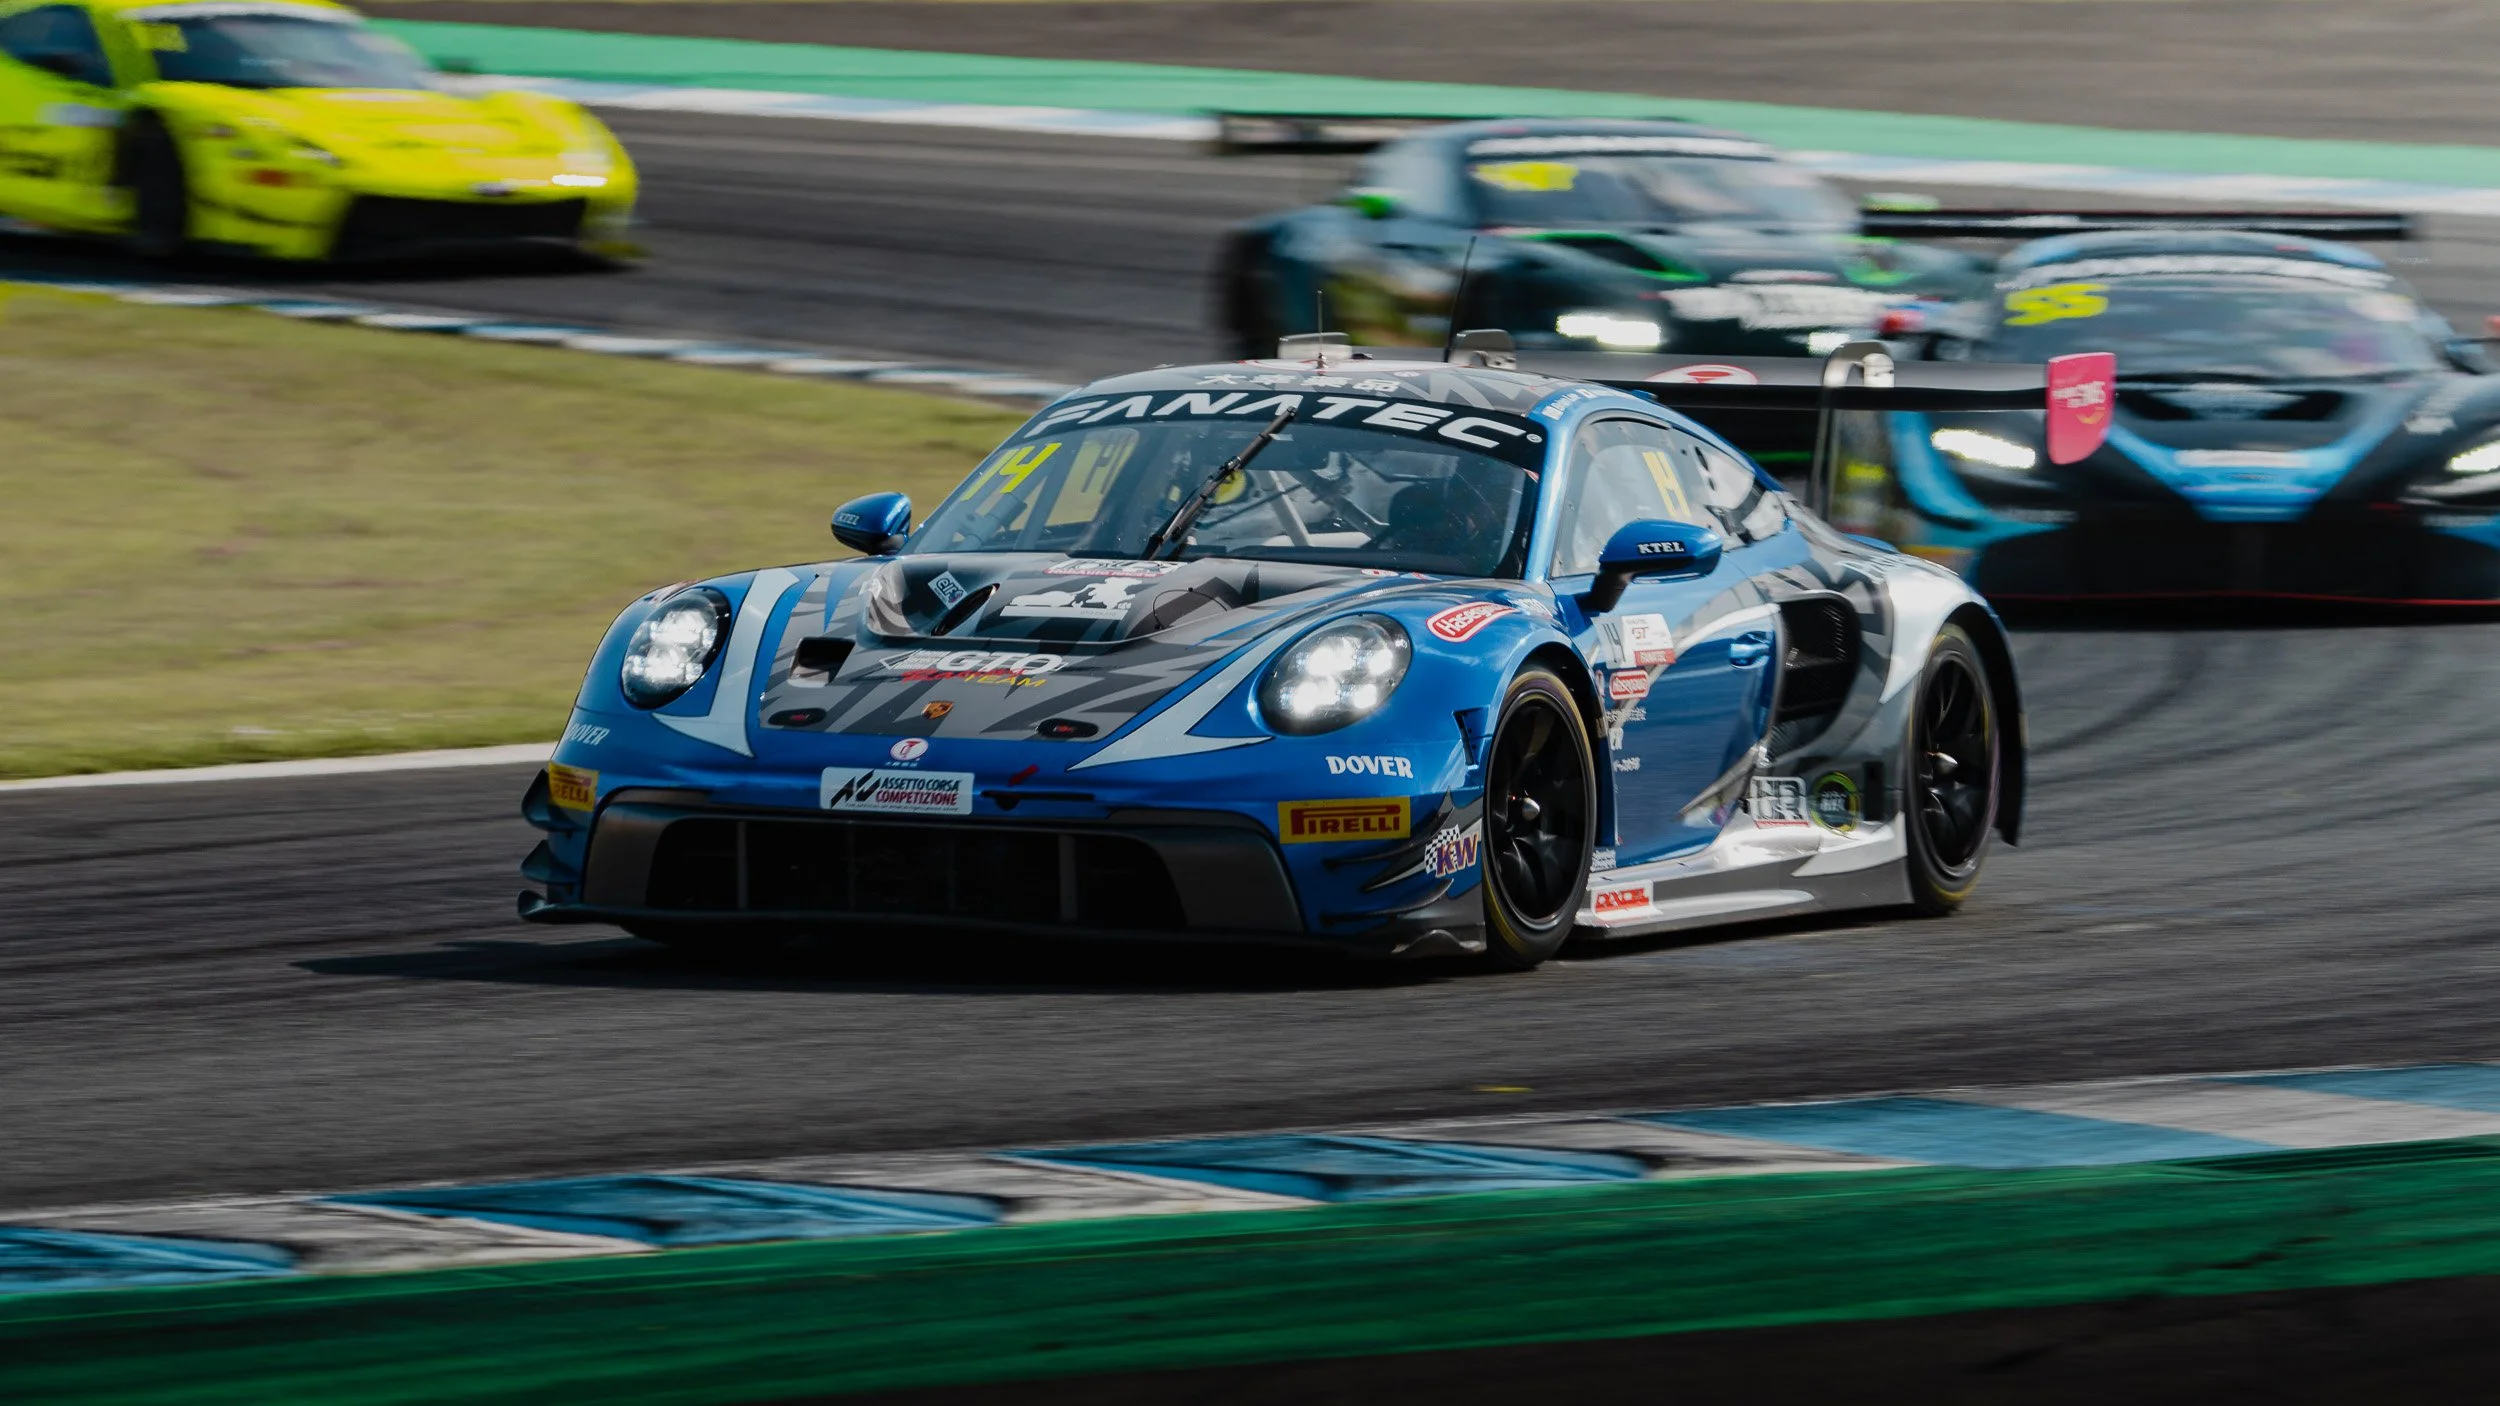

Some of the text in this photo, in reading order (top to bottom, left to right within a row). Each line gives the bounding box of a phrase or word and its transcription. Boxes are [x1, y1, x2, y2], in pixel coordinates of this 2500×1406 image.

[1025, 392, 1527, 449] FANATEC
[1637, 541, 1685, 554] KTEL
[935, 651, 1064, 675] GTO
[964, 674, 1047, 688] TEAM
[1325, 755, 1414, 779] DOVER
[880, 776, 963, 792] ASSETTO CORSA
[875, 790, 958, 806] COMPETIZIONE
[1290, 804, 1401, 836] PIRELLI
[1435, 832, 1479, 878] KW
